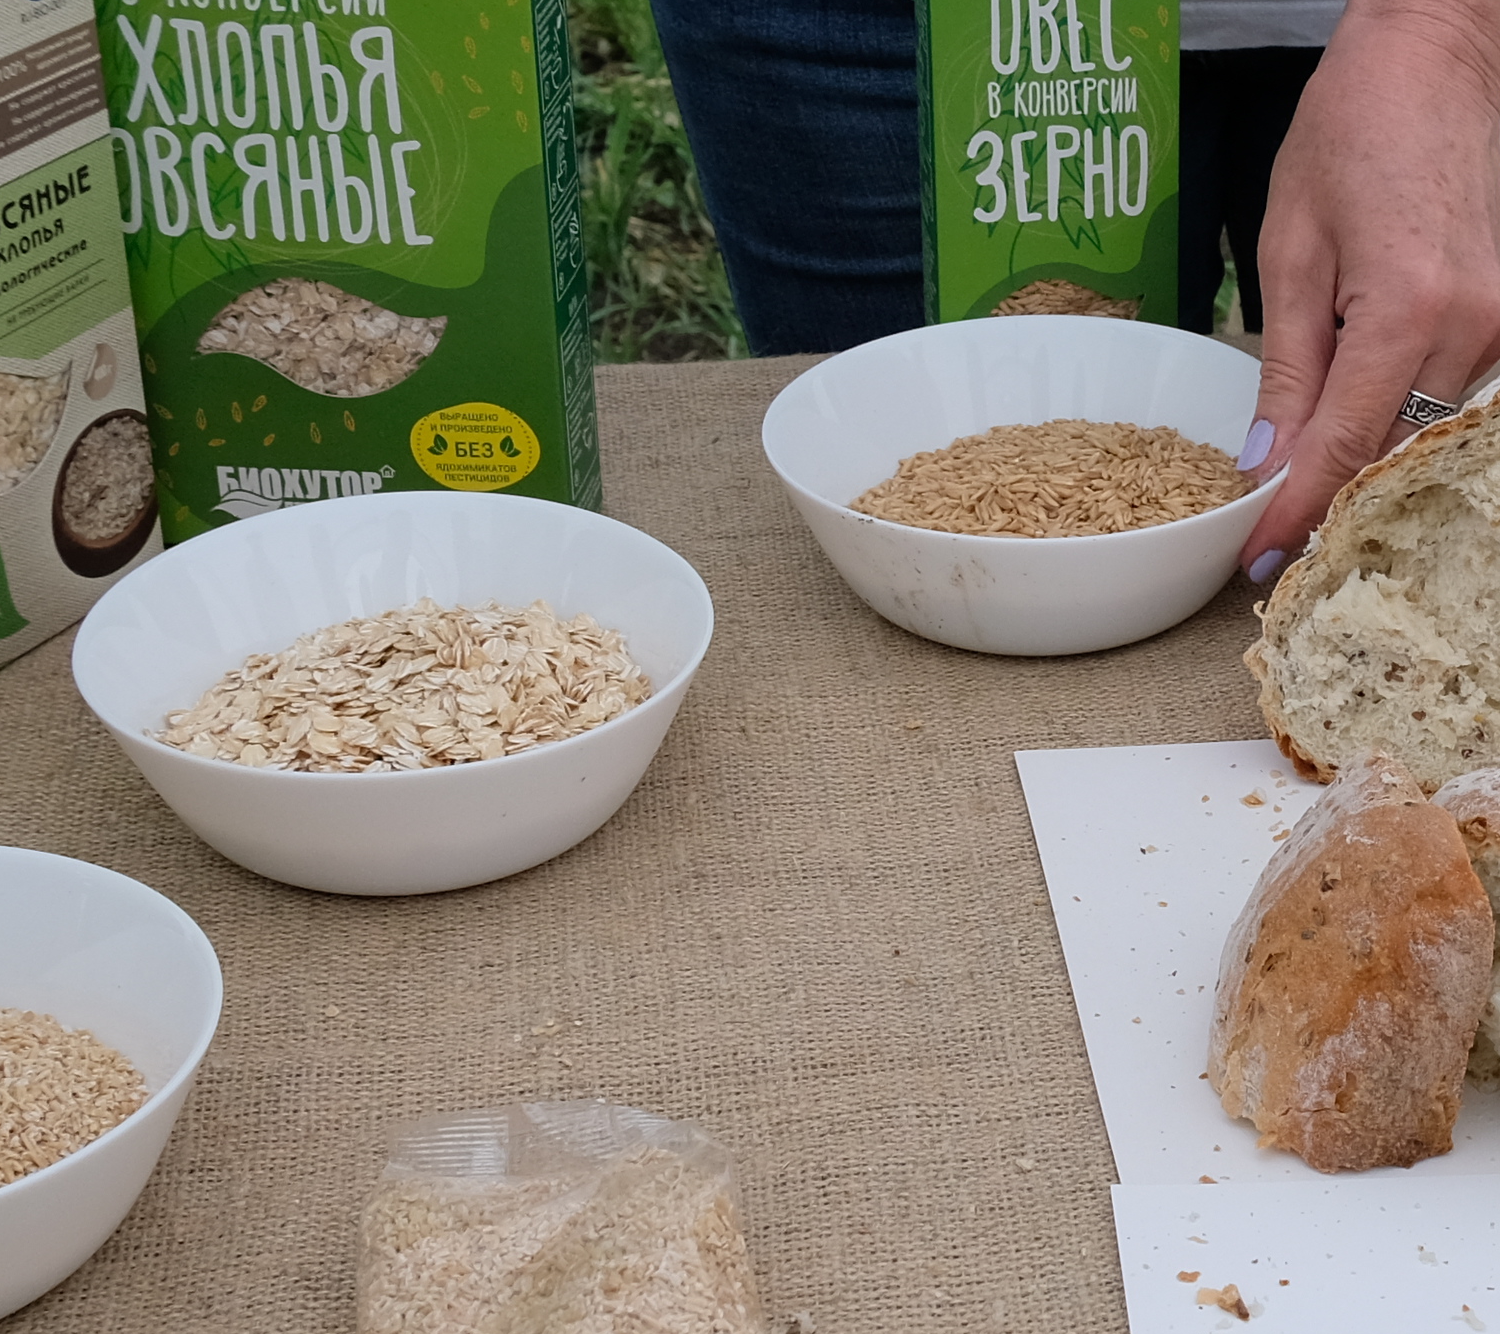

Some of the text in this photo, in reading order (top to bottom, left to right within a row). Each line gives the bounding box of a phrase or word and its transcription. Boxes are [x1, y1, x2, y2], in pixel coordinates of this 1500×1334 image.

[116, 15, 403, 134] ХЛОПЬЯ
[987, 77, 1138, 119] В КОНВЕРСИИ
[966, 124, 1149, 223] ЗЕРНО
[439, 411, 499, 422] ВЫРАЩЕНО
[429, 423, 513, 434] И ПРОИЗВЕДЕНО
[454, 441, 494, 458] БЕЗ
[435, 463, 518, 473] ЯДОХИМИКАТОВ
[216, 466, 383, 499] БИОХУТОР
[444, 473, 511, 483] ПЕСТИЦИДОВ
